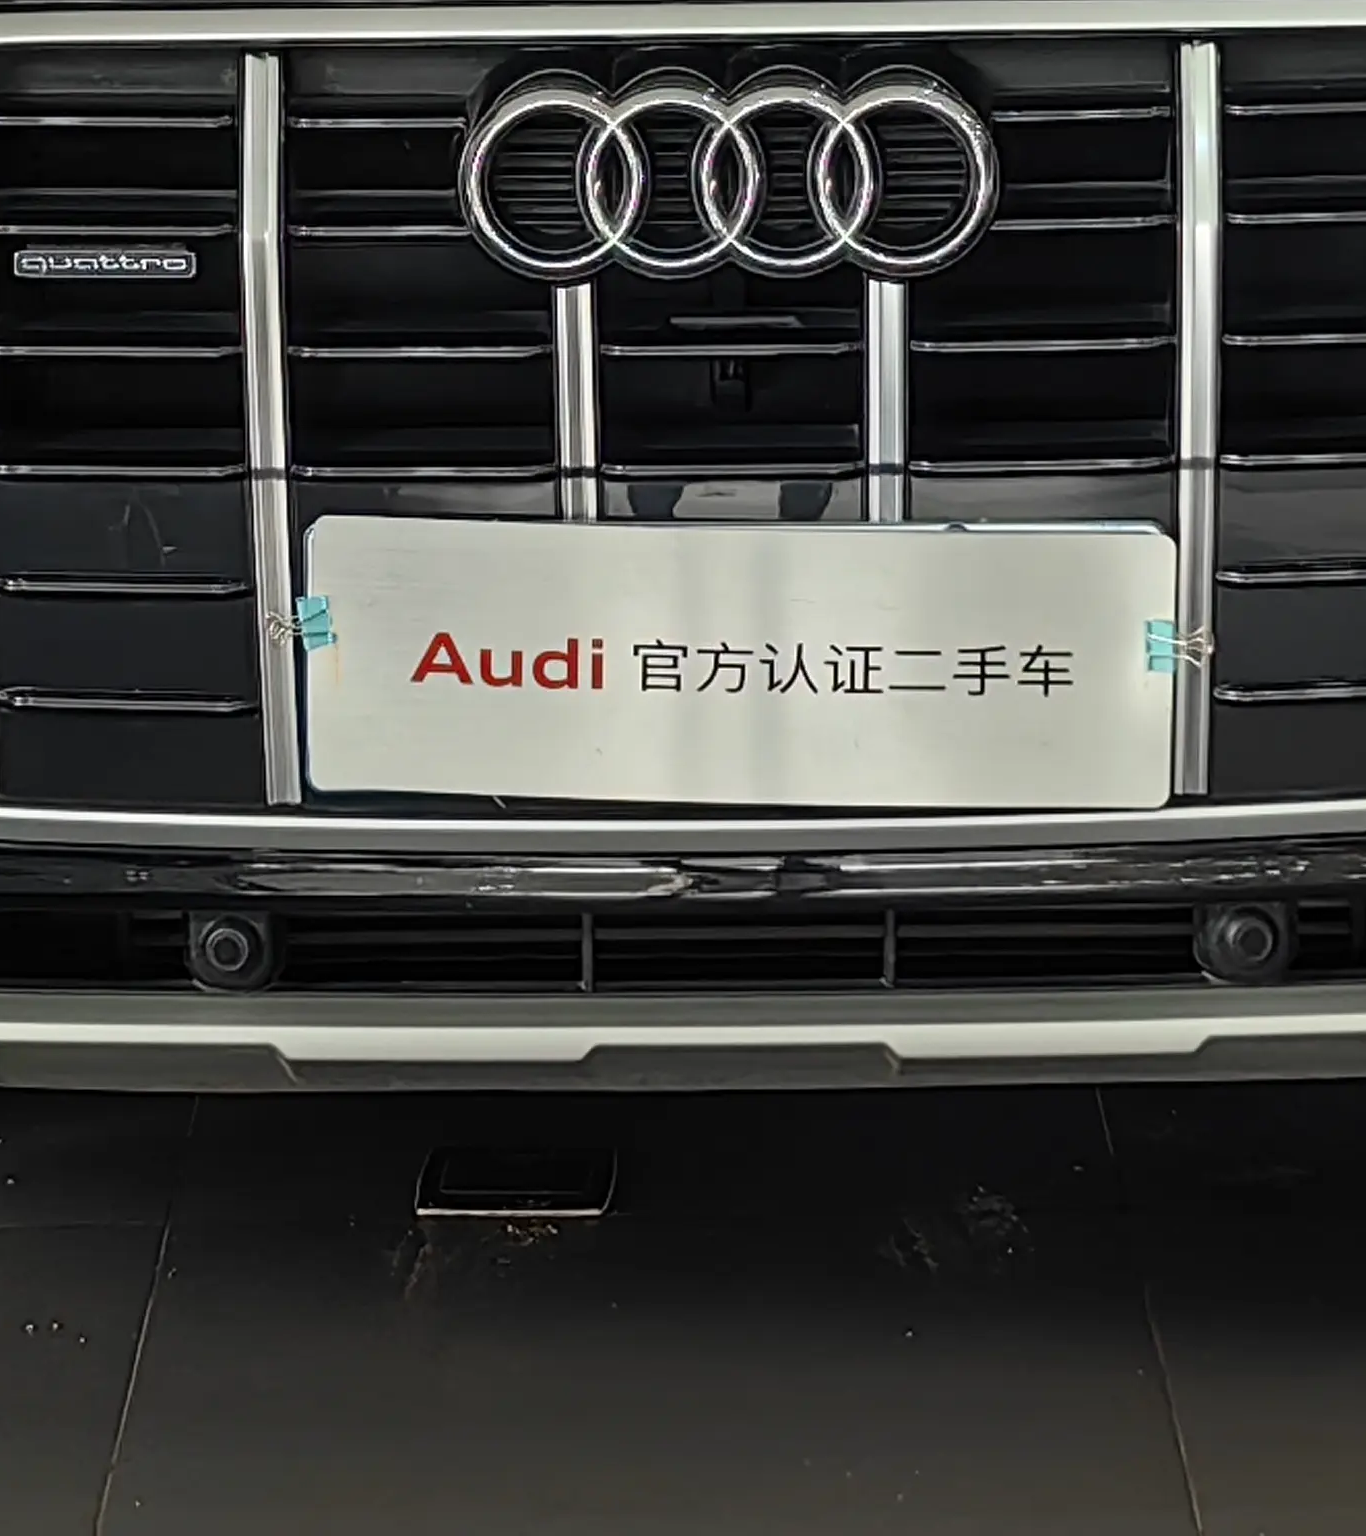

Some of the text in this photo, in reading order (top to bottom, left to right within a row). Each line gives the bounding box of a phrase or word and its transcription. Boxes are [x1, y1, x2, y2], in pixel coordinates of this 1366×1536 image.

[20, 254, 187, 276] quattro
[410, 630, 1075, 697] Audi 官方认证二手车
